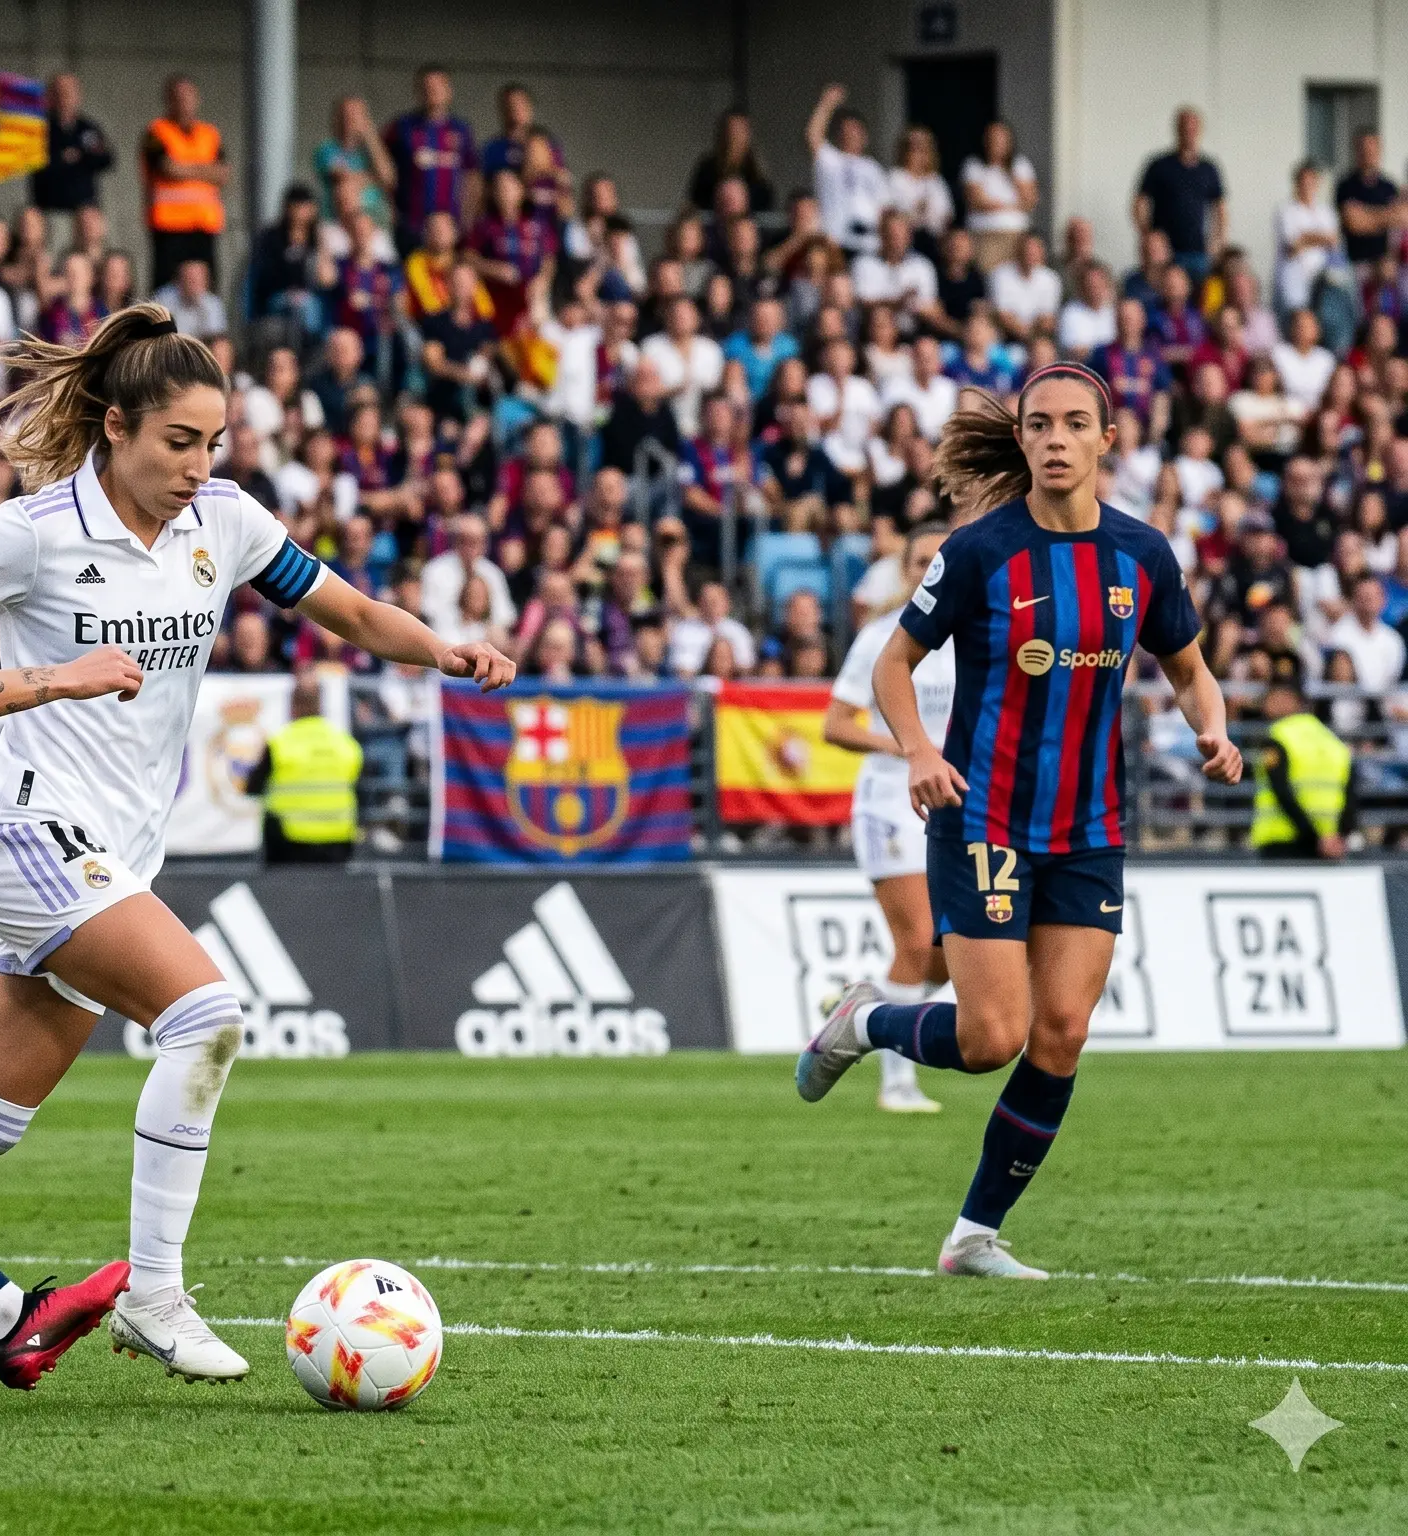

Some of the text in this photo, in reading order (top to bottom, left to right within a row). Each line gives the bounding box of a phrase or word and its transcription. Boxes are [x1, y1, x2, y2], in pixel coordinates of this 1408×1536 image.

[73, 610, 215, 644] Emirates
[1059, 649, 1126, 670] Spotify
[967, 842, 1019, 891] 12
[1238, 915, 1302, 956] DA
[1245, 970, 1306, 1012] ZN
[455, 998, 670, 1057] adidas
